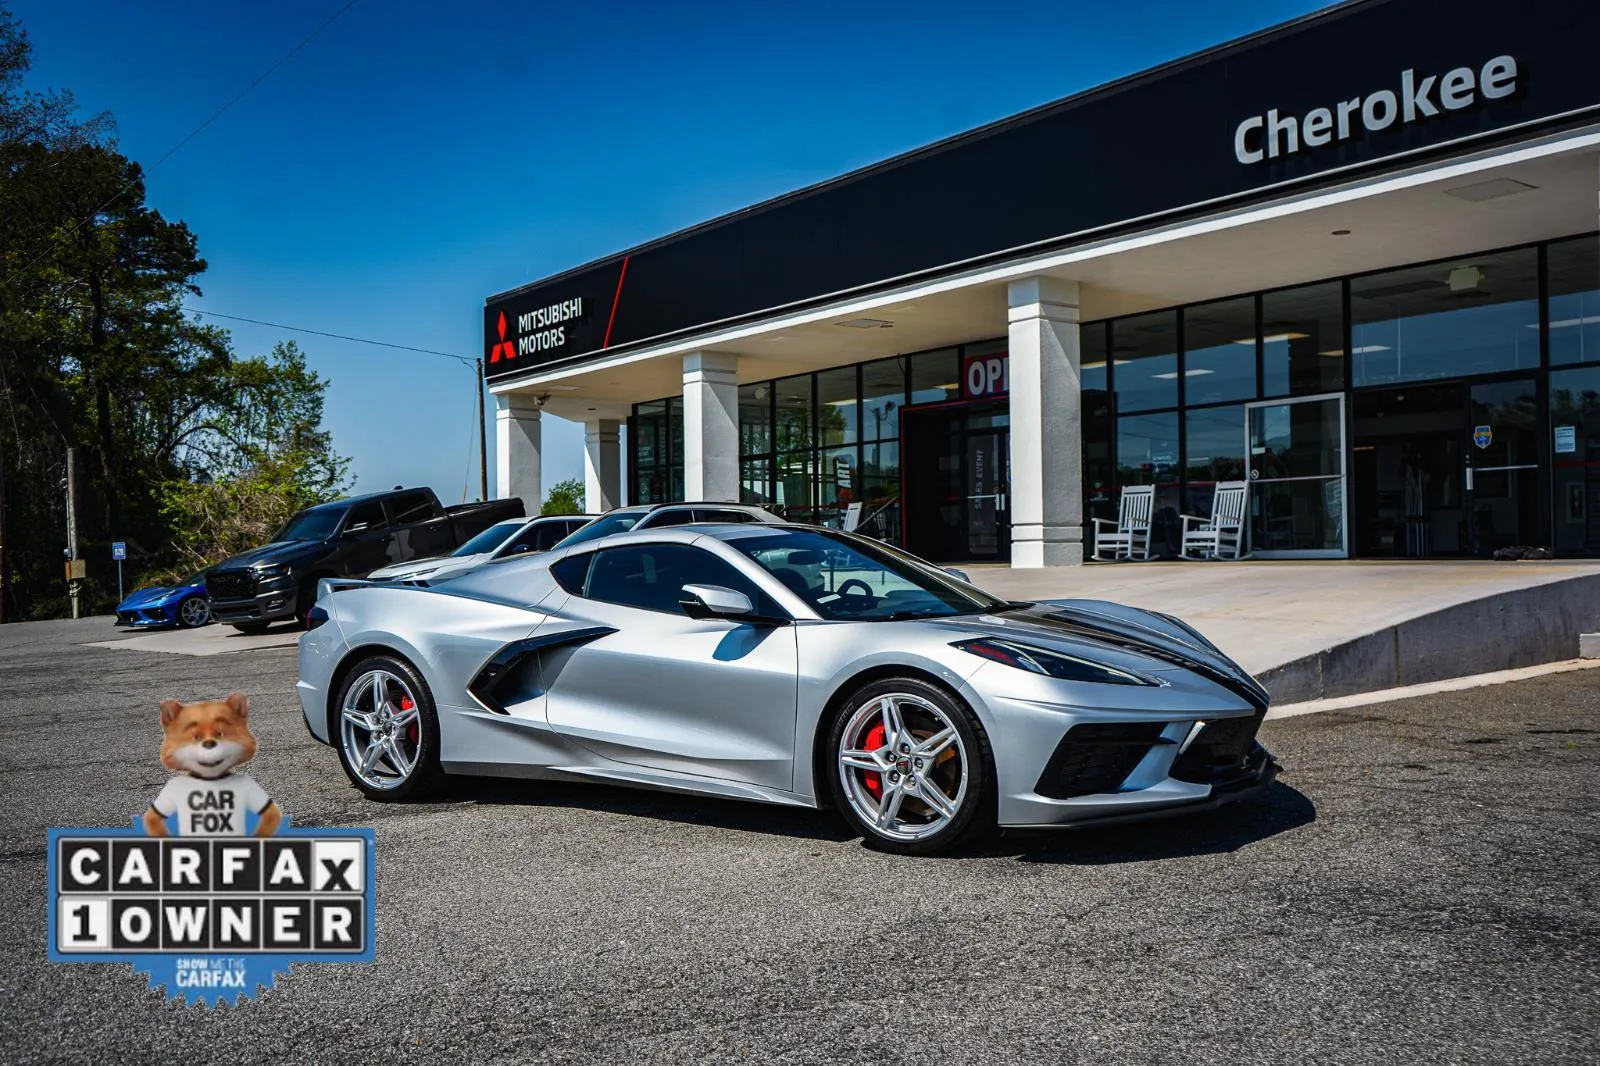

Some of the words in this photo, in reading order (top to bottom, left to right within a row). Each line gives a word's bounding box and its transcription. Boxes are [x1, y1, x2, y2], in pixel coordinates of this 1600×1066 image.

[1234, 54, 1518, 165] Cherokee
[518, 297, 582, 333] MITSUBISHI
[518, 326, 565, 356] MOTORS
